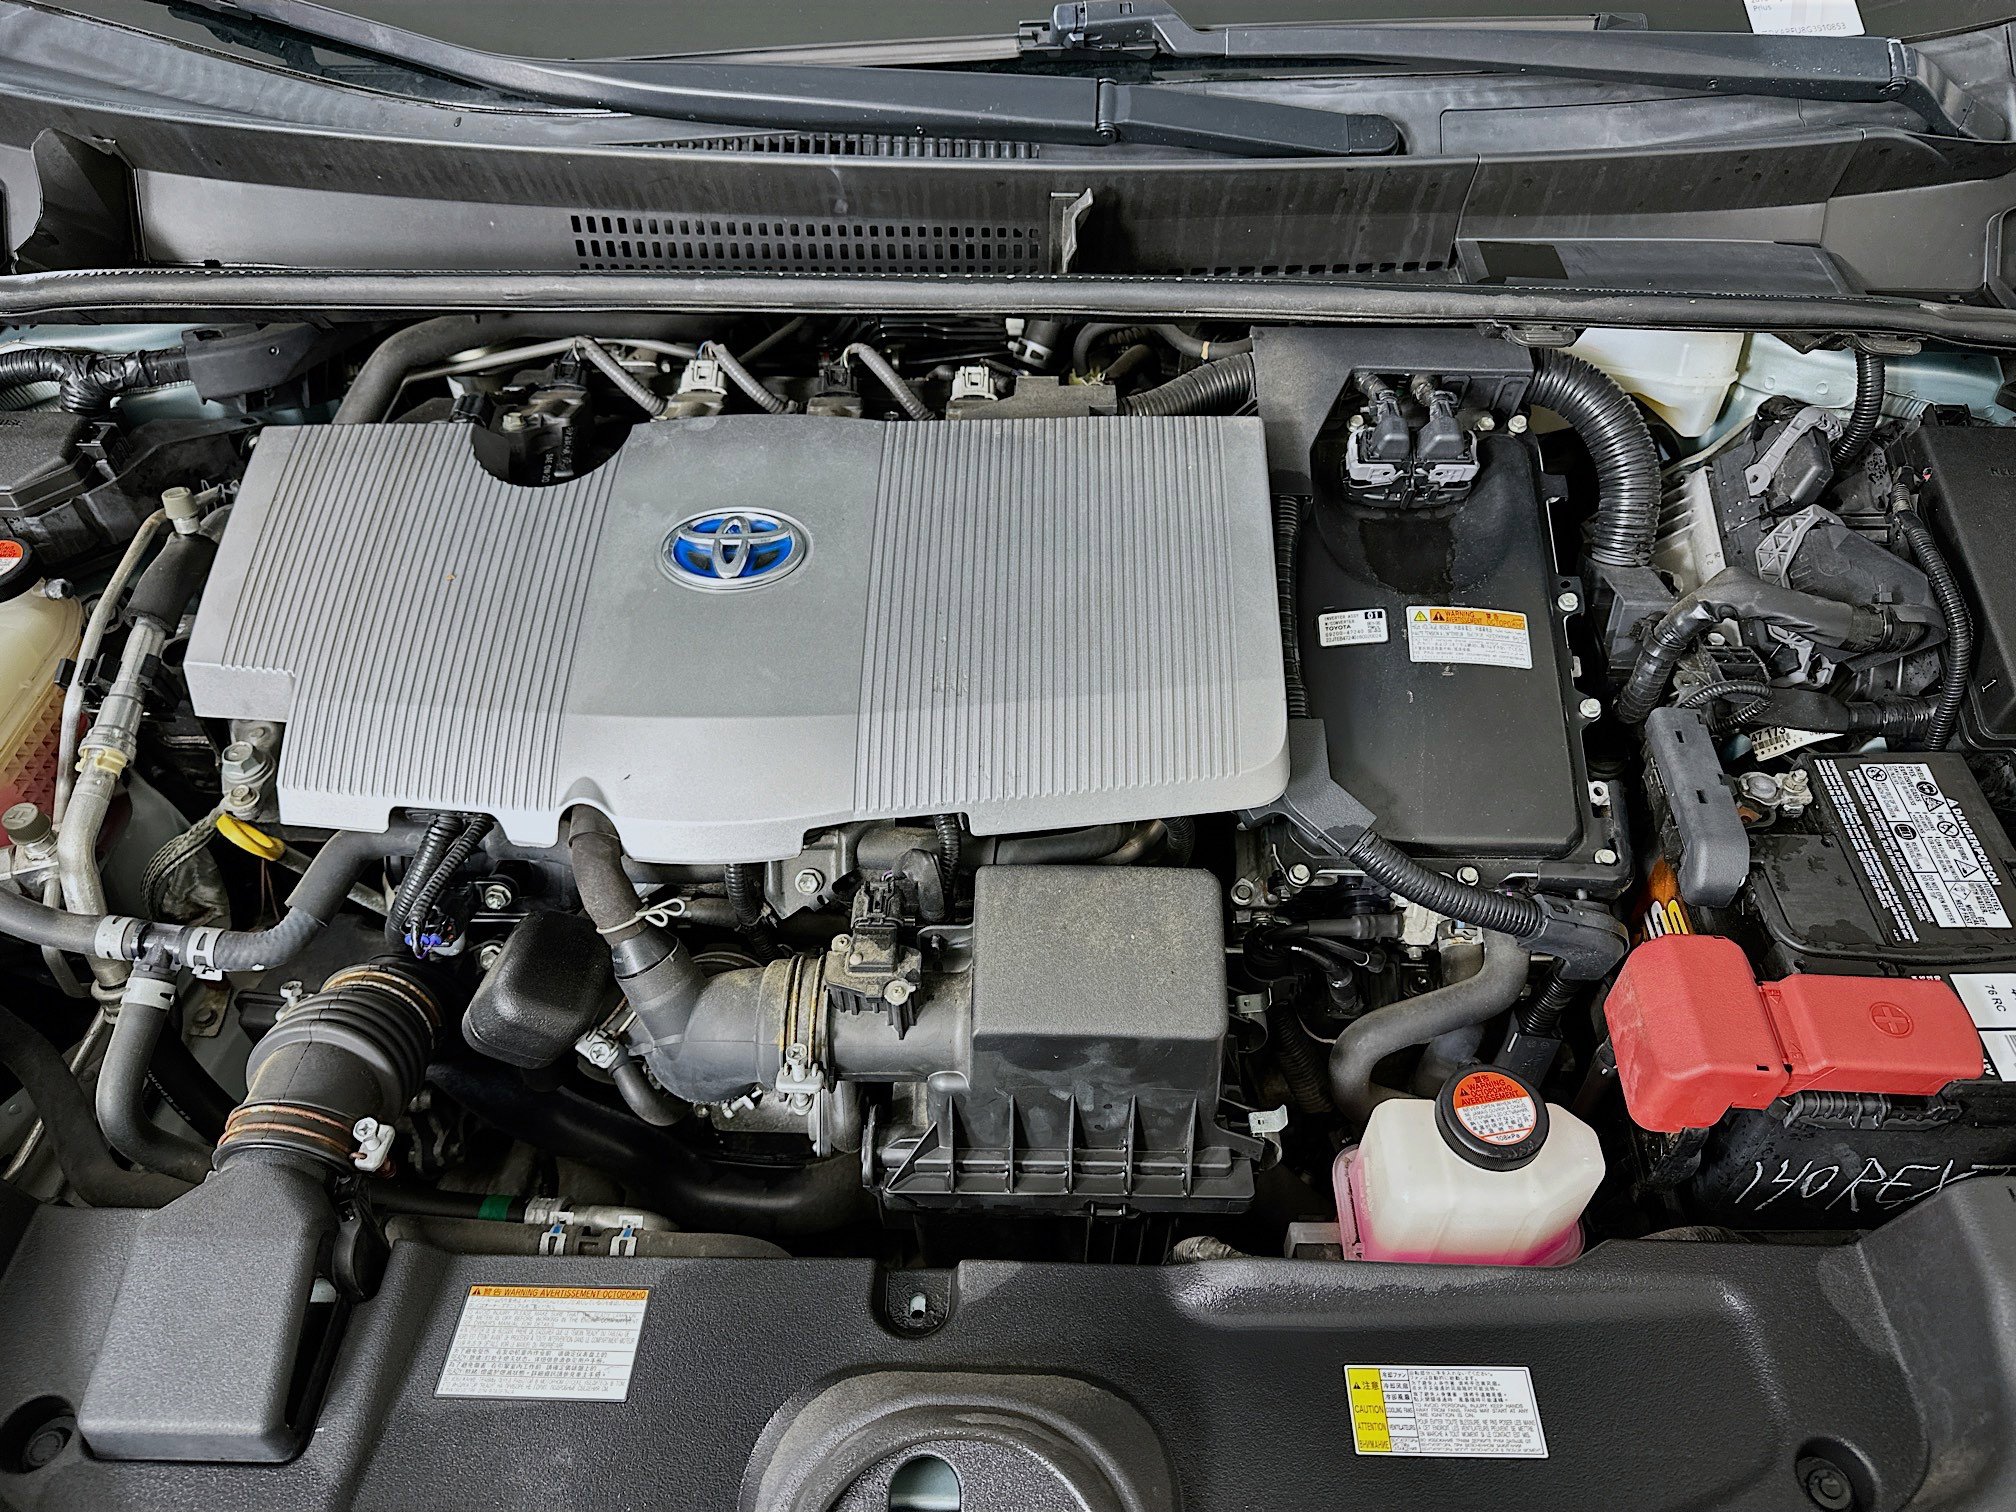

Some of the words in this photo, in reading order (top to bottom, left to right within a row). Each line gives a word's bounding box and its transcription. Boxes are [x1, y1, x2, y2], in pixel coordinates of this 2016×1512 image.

[1445, 617, 1482, 625] AVERTISSEMENT
[1913, 766, 1926, 780] SHIELD
[1898, 766, 1914, 787] EXPLOSIVE
[1909, 788, 1921, 801] GASES
[1945, 839, 1955, 849] ACID
[1952, 838, 1969, 860] SULFURIC
[1953, 808, 2001, 886] DANGER/POISON
[1923, 882, 1933, 890] NOT
[1930, 882, 1940, 890] NOT
[1934, 891, 1946, 903] OPEN
[1974, 883, 1996, 914] IMMEDIATELY
[1954, 899, 1966, 911] HELP
[1989, 898, 2001, 910] EYES
[1964, 904, 1981, 925] MEDICAL
[1977, 916, 1988, 925] GET
[1985, 985, 1997, 995] 76
[1992, 998, 2006, 1011] RC
[1467, 1079, 1505, 1090] WARNING
[1462, 1090, 1519, 1105] AVERTISSEMENT
[504, 1289, 538, 1297] WARNING
[540, 1289, 600, 1298] AVERTISSEMENT
[1363, 1381, 1379, 1390] 注意
[1355, 1405, 1384, 1413] CAUTION
